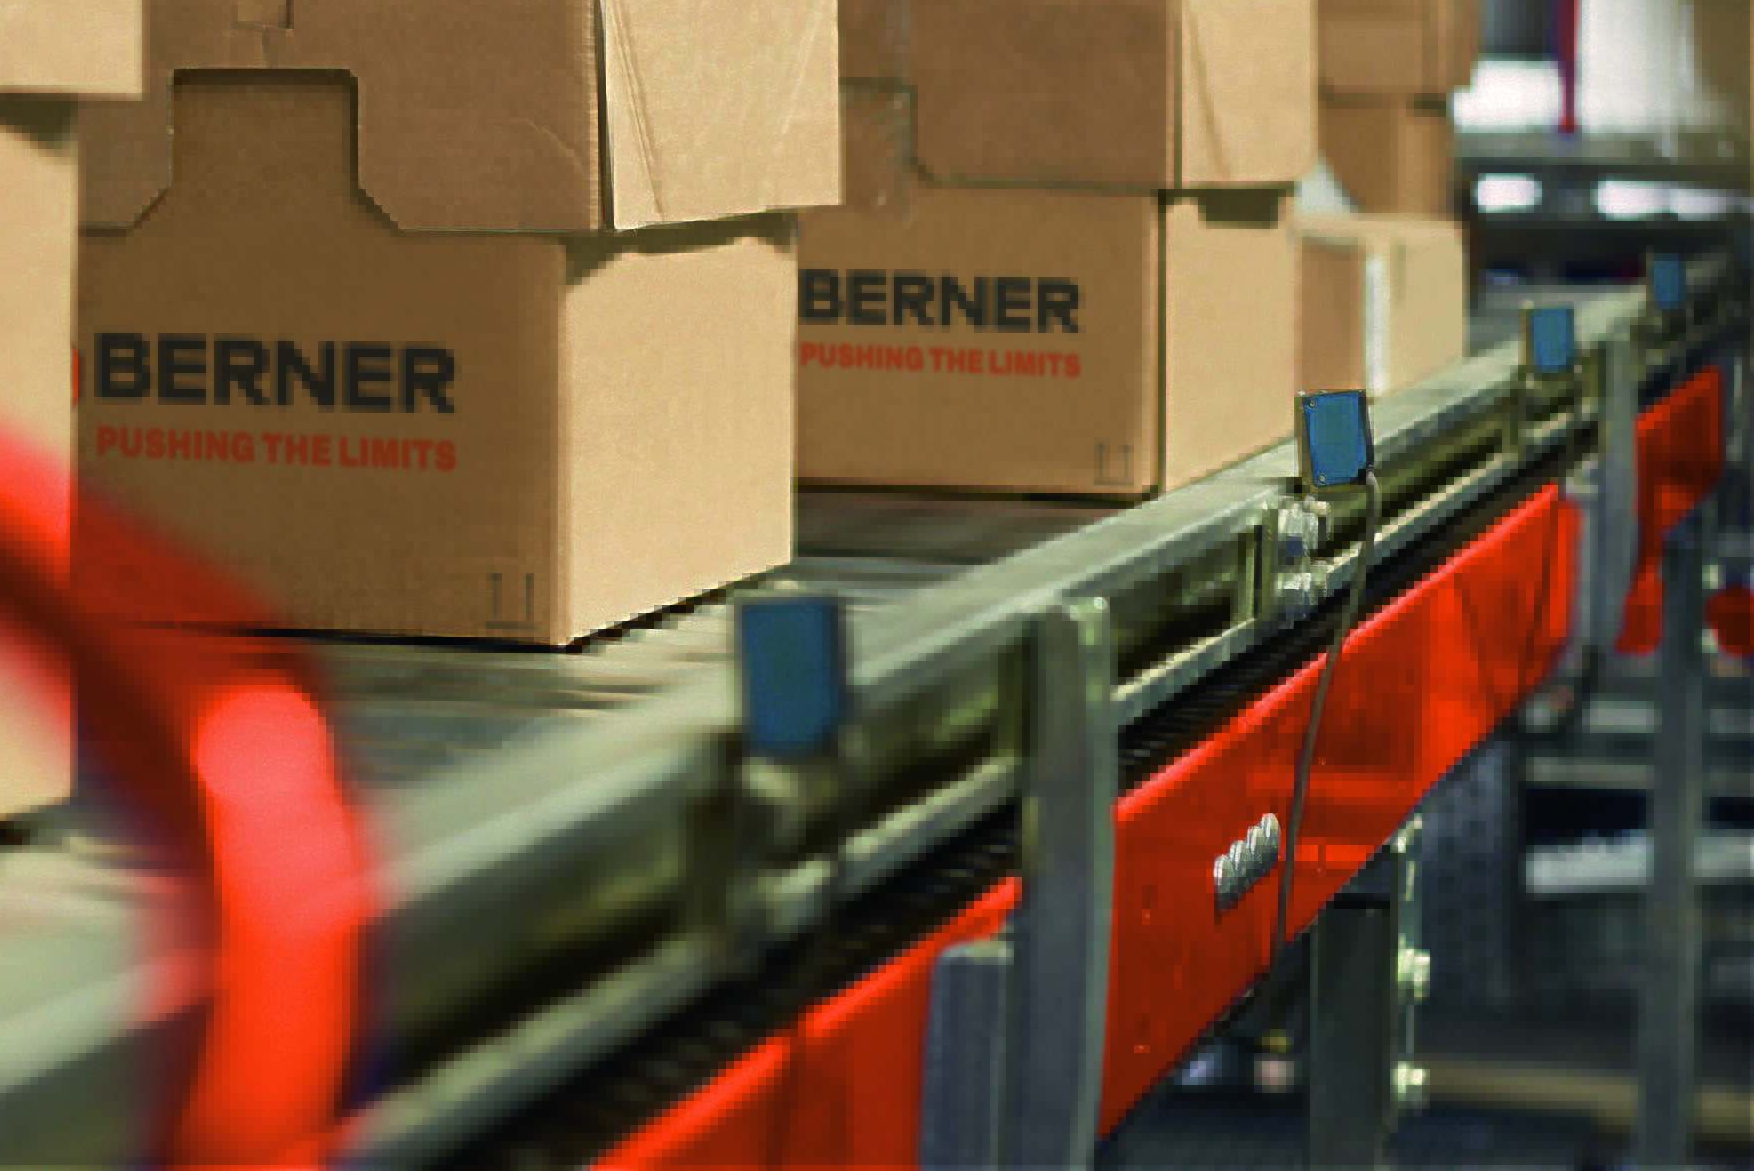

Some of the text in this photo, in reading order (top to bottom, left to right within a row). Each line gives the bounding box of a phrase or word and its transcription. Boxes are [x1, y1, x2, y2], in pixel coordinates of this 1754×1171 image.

[798, 269, 1083, 333] BERNER
[95, 333, 458, 414] BERNER
[799, 341, 1082, 378] PUSHING THE LIMITS
[96, 425, 458, 472] PUSHING THE LIMITS
